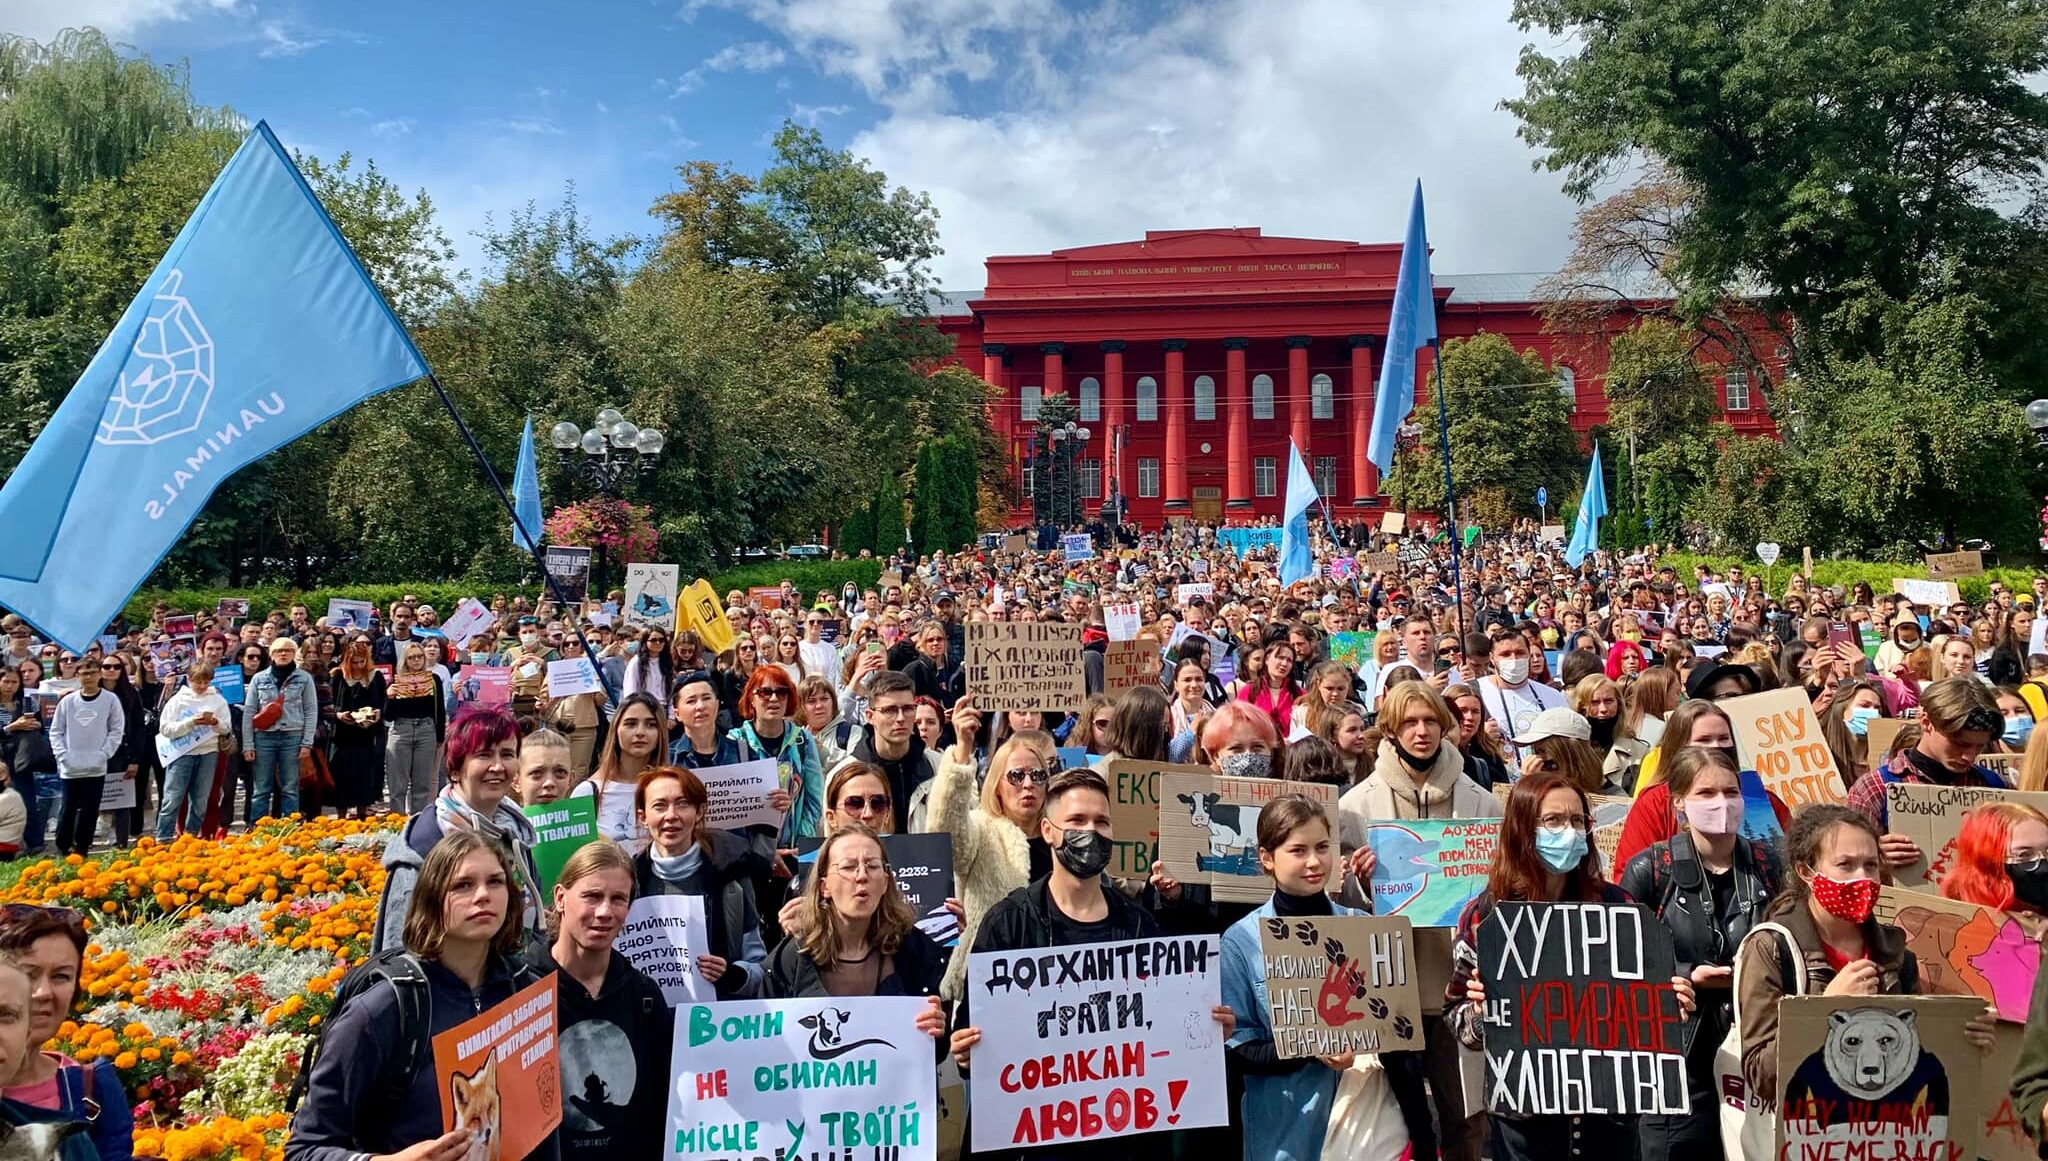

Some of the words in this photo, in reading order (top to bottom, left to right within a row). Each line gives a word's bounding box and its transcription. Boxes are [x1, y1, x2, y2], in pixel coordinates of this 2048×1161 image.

[548, 555, 571, 566] THEIR
[572, 555, 590, 567] LIFE
[970, 666, 990, 682] НЕ
[1755, 708, 1806, 748] SAY
[1756, 751, 1790, 778] NO
[1792, 743, 1829, 772] TO
[1765, 771, 1847, 808] ASTIC
[542, 823, 590, 842] ТВАРИН!
[899, 866, 929, 878] 2232
[1374, 882, 1414, 896] НЕВОЛЯ
[618, 935, 654, 953] 5409
[1495, 904, 1644, 981] ХУТРО
[640, 962, 694, 975] ИРКОВИХ
[1265, 954, 1327, 980] НАСИЛЛЮ
[456, 1013, 513, 1061] ВИМАГАЄМО
[513, 988, 553, 1027] ЗАБОРОНИ
[1269, 987, 1317, 1026] НАД
[1482, 998, 1512, 1027] ЦЕ
[1519, 980, 1681, 1054] КРИВАВЕ
[1273, 1027, 1380, 1058] ТВАРИНАМИ
[696, 1068, 728, 1101] НЕ
[753, 1059, 877, 1092] ОБИРАЛИ
[1484, 1048, 1691, 1115] ЖЛОБСТВО
[820, 1101, 920, 1147] ТВОЇЙ
[1012, 1080, 1189, 1144] ЛЮБОВ!
[1784, 1098, 1838, 1137] HEY
